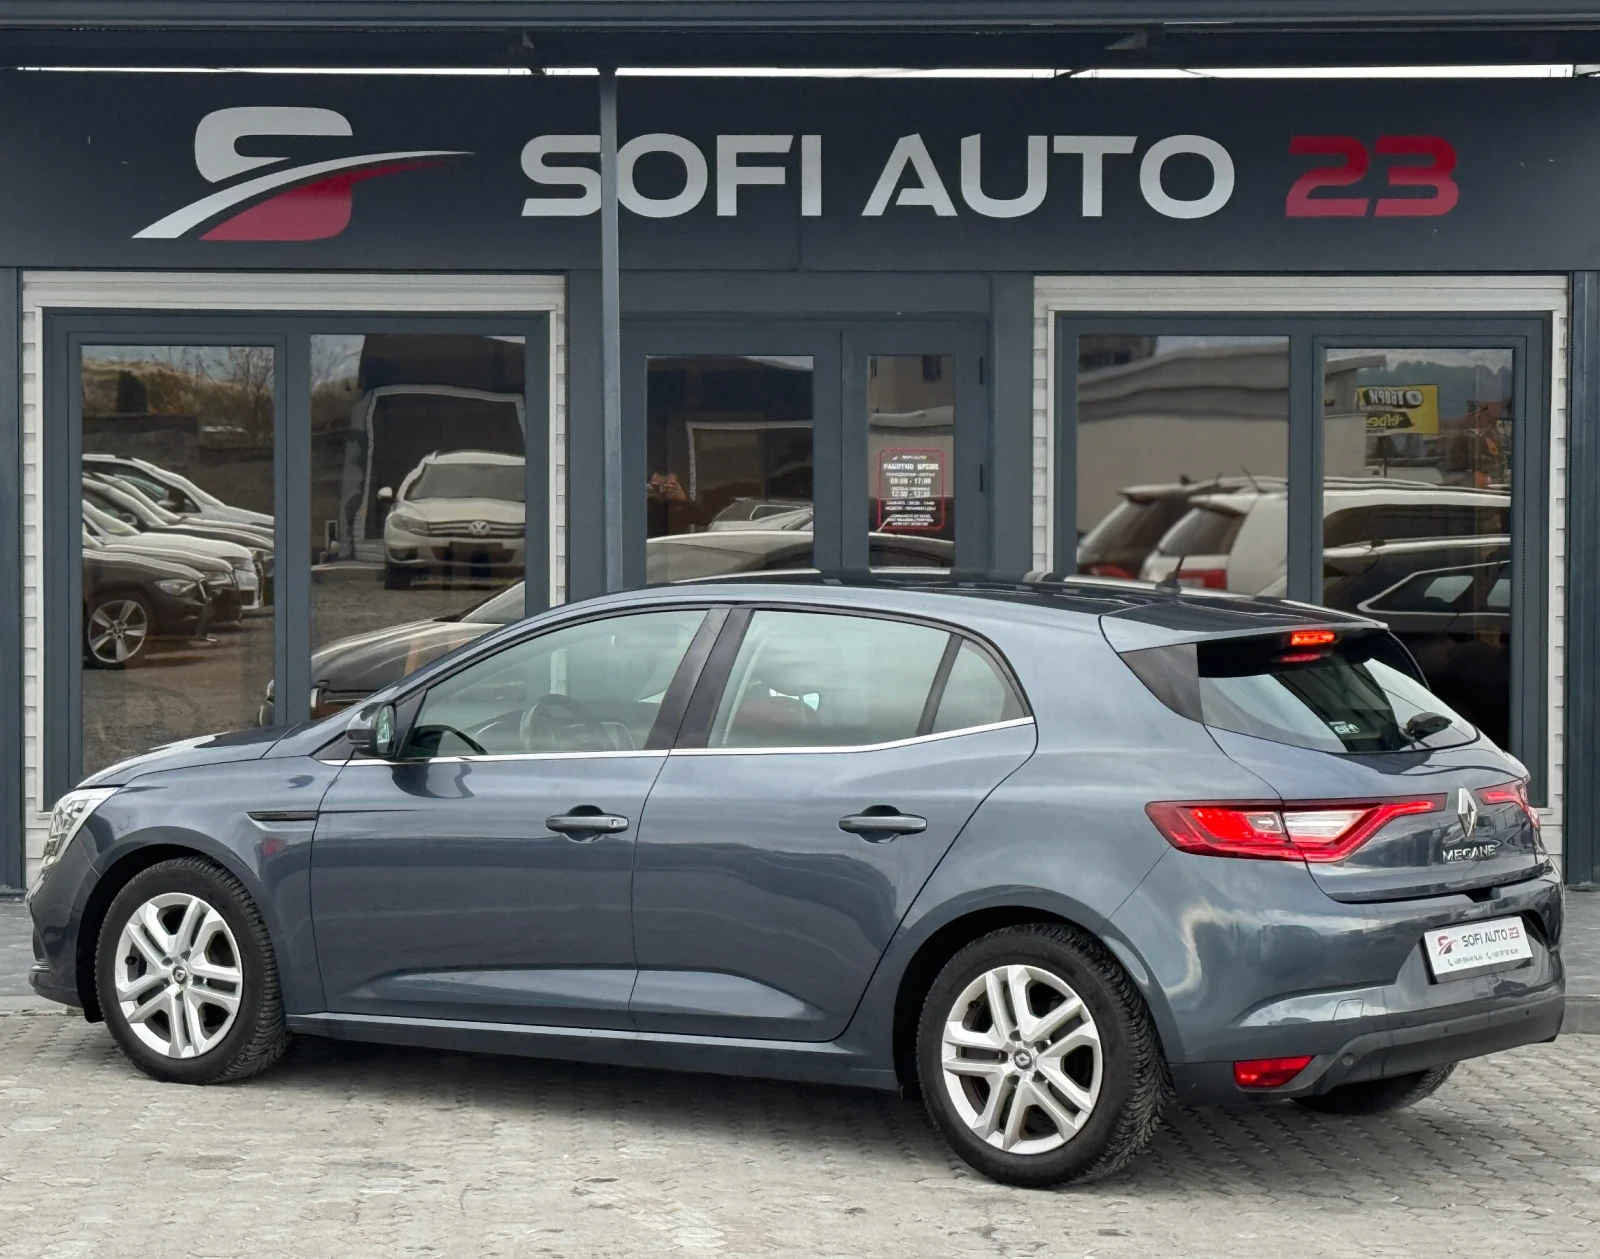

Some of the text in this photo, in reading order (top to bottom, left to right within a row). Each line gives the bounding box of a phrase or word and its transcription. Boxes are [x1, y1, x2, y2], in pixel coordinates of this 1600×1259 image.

[520, 133, 1460, 219] SOFI AUTO 23
[1442, 844, 1497, 862] MEGANE
[1461, 932, 1483, 948] SOFI
[1485, 928, 1508, 944] AUTO
